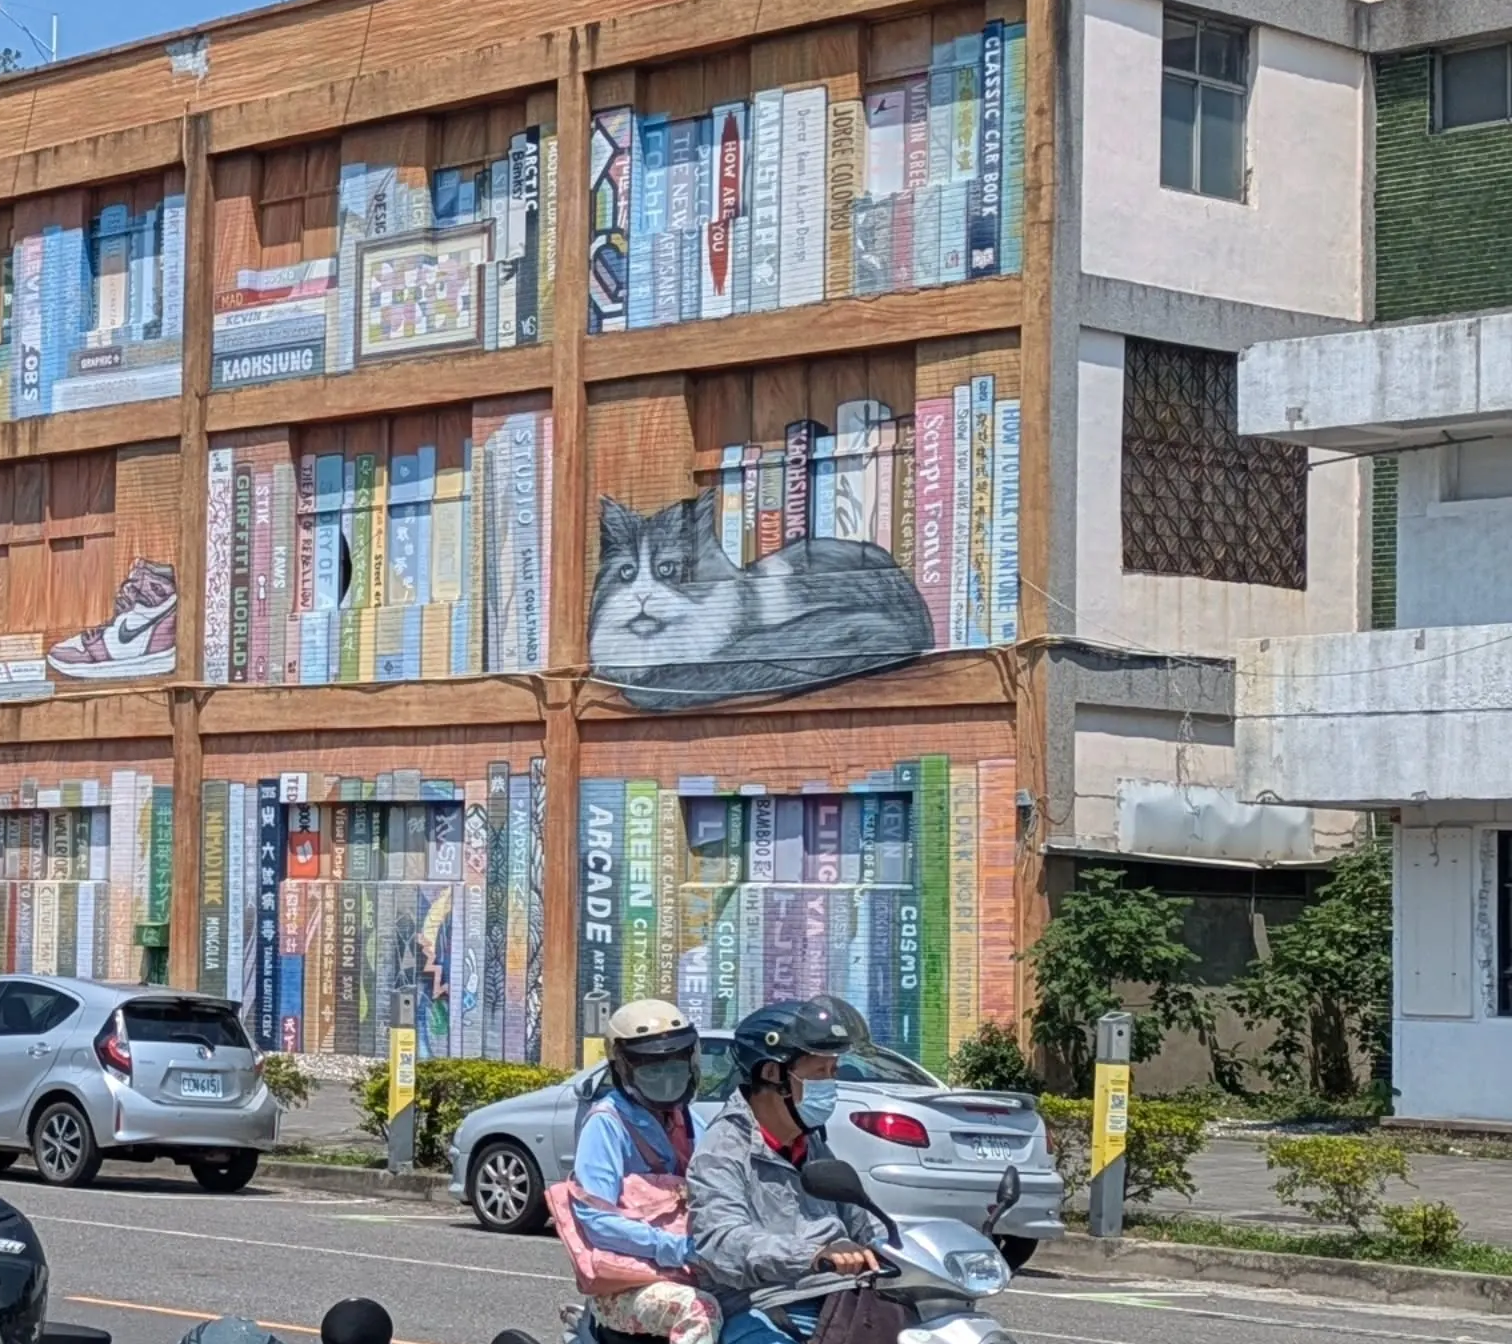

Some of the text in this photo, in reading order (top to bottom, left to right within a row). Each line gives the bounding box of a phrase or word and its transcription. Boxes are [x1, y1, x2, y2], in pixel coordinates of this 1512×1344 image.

[673, 131, 691, 178] THE
[831, 107, 855, 159] JORGE
[982, 36, 1000, 218] CLASSIC CAR BOOK
[511, 151, 525, 201] Banksy
[524, 142, 539, 212] ARCTIC
[712, 140, 737, 253] HOW ARE YOU
[672, 182, 689, 231] NEW
[222, 348, 314, 383] KAOHSIUNG
[1003, 408, 1021, 445] HOW
[255, 485, 270, 525] STIK
[514, 428, 533, 527] STUDIO
[786, 428, 808, 540] KAOHSIUNG
[919, 412, 945, 584] Script Fonts
[232, 474, 251, 666] GRAFFITI WORLD
[272, 545, 286, 589] KAWS
[316, 557, 334, 587] OF
[373, 552, 384, 587] Street
[286, 775, 299, 803] TED
[629, 795, 654, 907] GREEN
[662, 827, 676, 848] ART
[755, 798, 771, 857] BAMBOO
[819, 805, 839, 882] LING
[882, 798, 902, 858] KEVIN
[586, 804, 614, 945] ARCADE
[662, 854, 676, 870] OF
[660, 874, 675, 938] CALENDAR
[952, 870, 974, 934] WORK
[205, 916, 221, 970] MONGOLIA
[342, 897, 356, 968] DESIGN
[631, 918, 648, 960] CITY
[718, 920, 736, 1000] COLOUR
[901, 906, 918, 990] COSMO
[592, 950, 605, 972] ART
[659, 943, 673, 994] DESIGN
